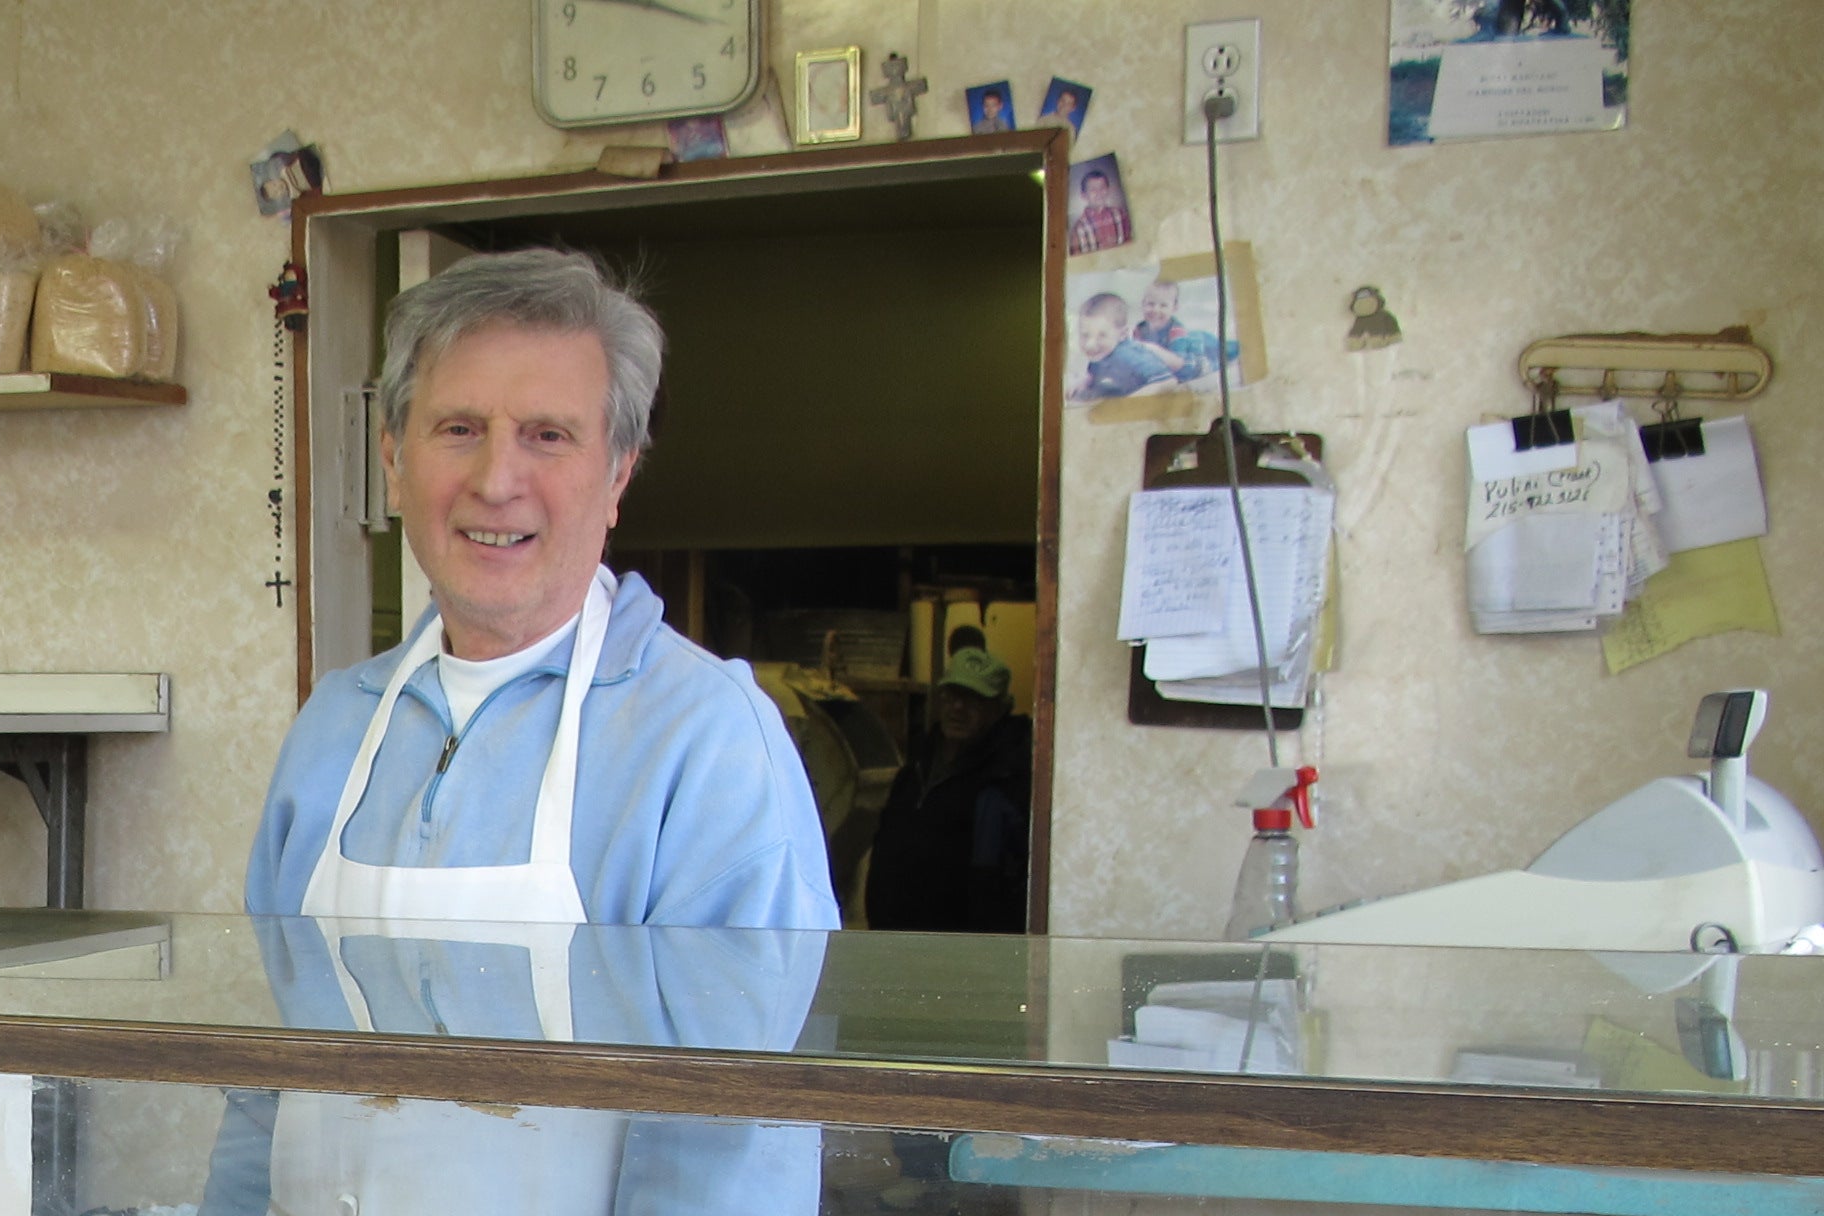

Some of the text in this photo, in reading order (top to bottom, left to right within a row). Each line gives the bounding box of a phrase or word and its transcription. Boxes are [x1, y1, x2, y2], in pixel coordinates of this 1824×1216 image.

[562, 3, 577, 27] 9
[720, 36, 735, 61] 4
[562, 56, 577, 81] 8
[691, 63, 707, 90] 5
[593, 75, 608, 101] 7
[640, 72, 656, 97] 6
